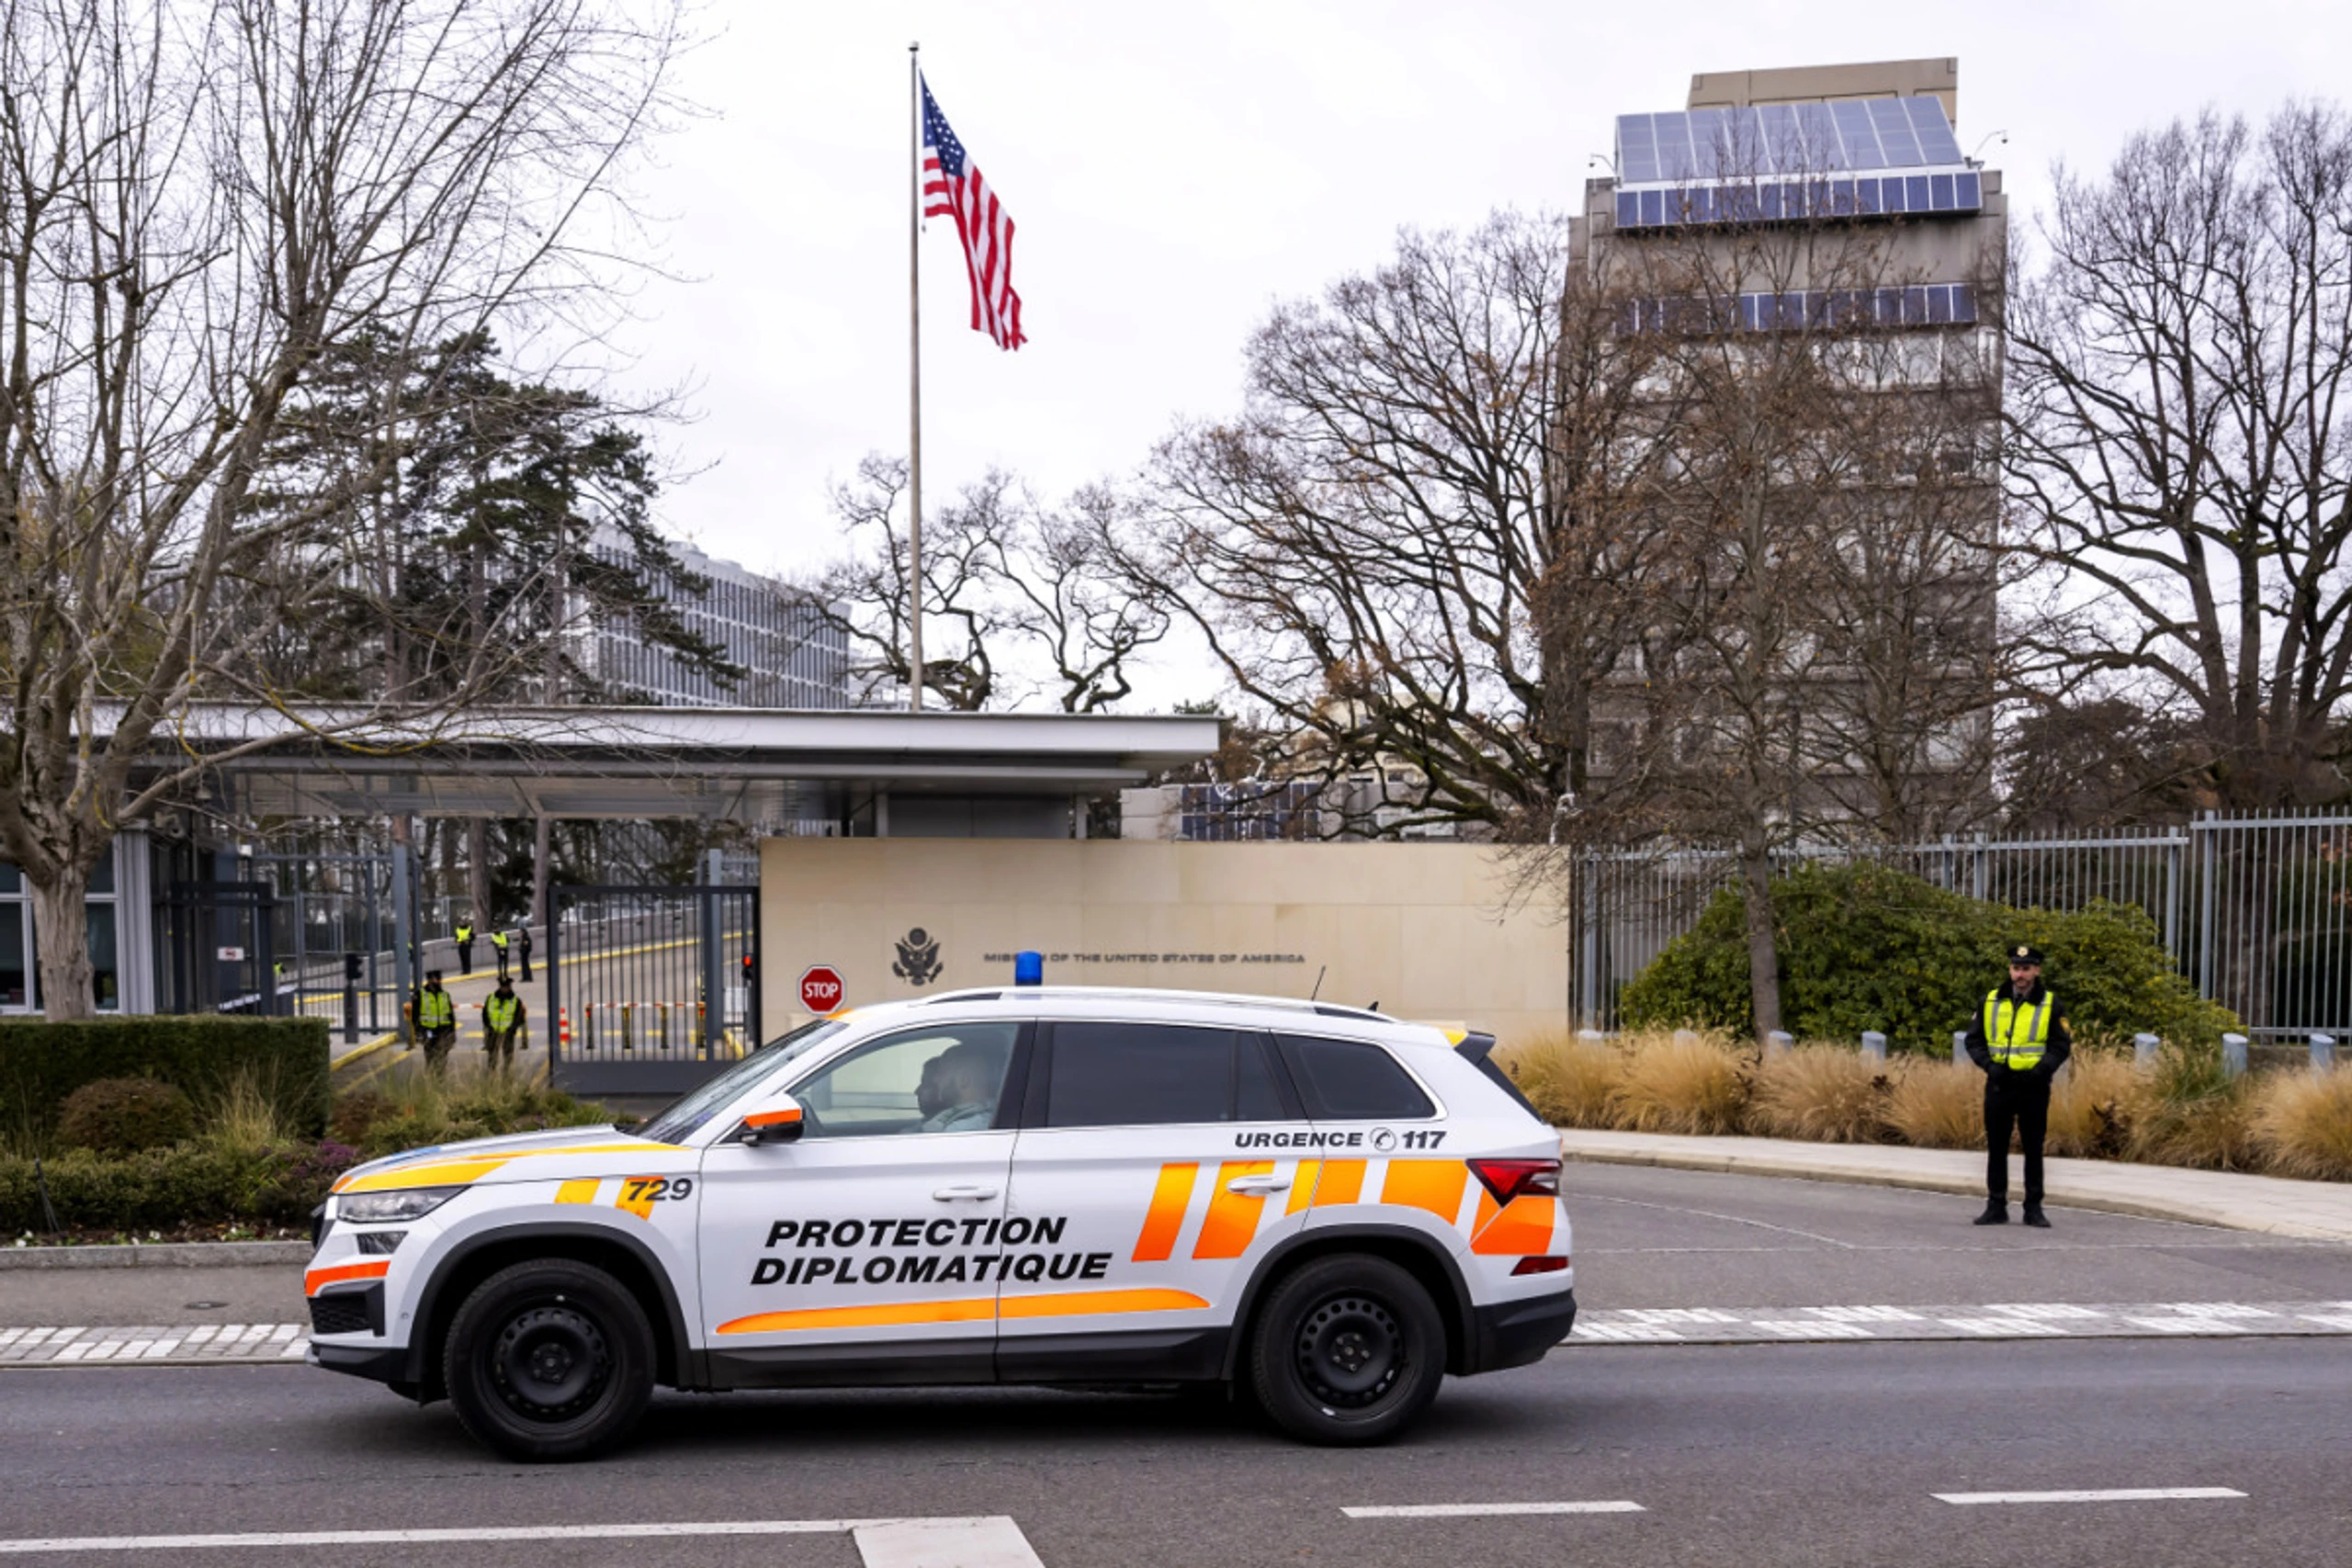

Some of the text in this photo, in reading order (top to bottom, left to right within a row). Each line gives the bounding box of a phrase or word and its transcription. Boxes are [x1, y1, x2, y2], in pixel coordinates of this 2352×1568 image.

[1050, 953, 1069, 963] OF
[1073, 953, 1101, 963] THE
[1104, 953, 1159, 963] UNITED
[1162, 953, 1215, 963] STATES
[1218, 953, 1237, 963] OF
[1240, 953, 1306, 963] AMERICA
[804, 982, 838, 999] STOP
[1234, 1130, 1447, 1149] URGENCE 117
[627, 1178, 693, 1201] 729
[764, 1216, 1068, 1247] PROTECTION
[750, 1252, 1114, 1285] DIPLOMATIQUE
